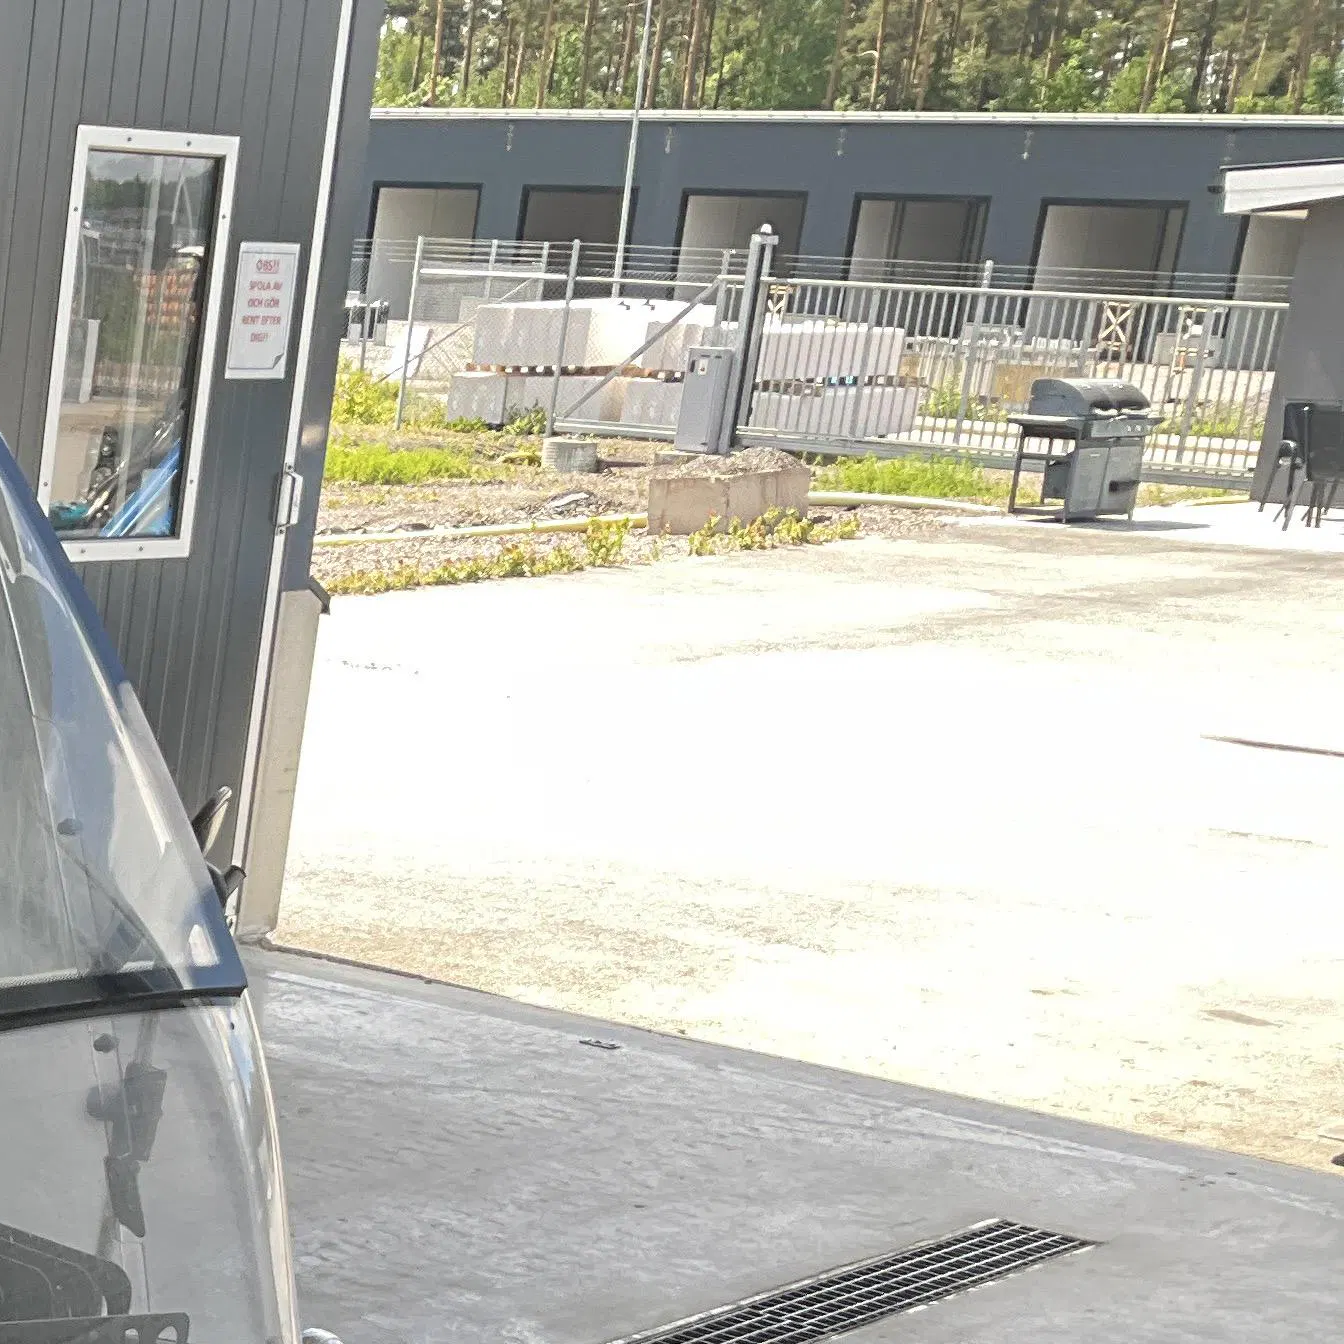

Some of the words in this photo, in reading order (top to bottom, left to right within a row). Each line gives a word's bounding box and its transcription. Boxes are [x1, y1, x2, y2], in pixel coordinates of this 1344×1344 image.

[249, 281, 270, 290] SPOLA
[272, 281, 283, 290] AV
[248, 299, 262, 308] OCH
[263, 297, 279, 308] GÖR
[242, 316, 260, 325] RENT
[261, 316, 281, 325] EFTER
